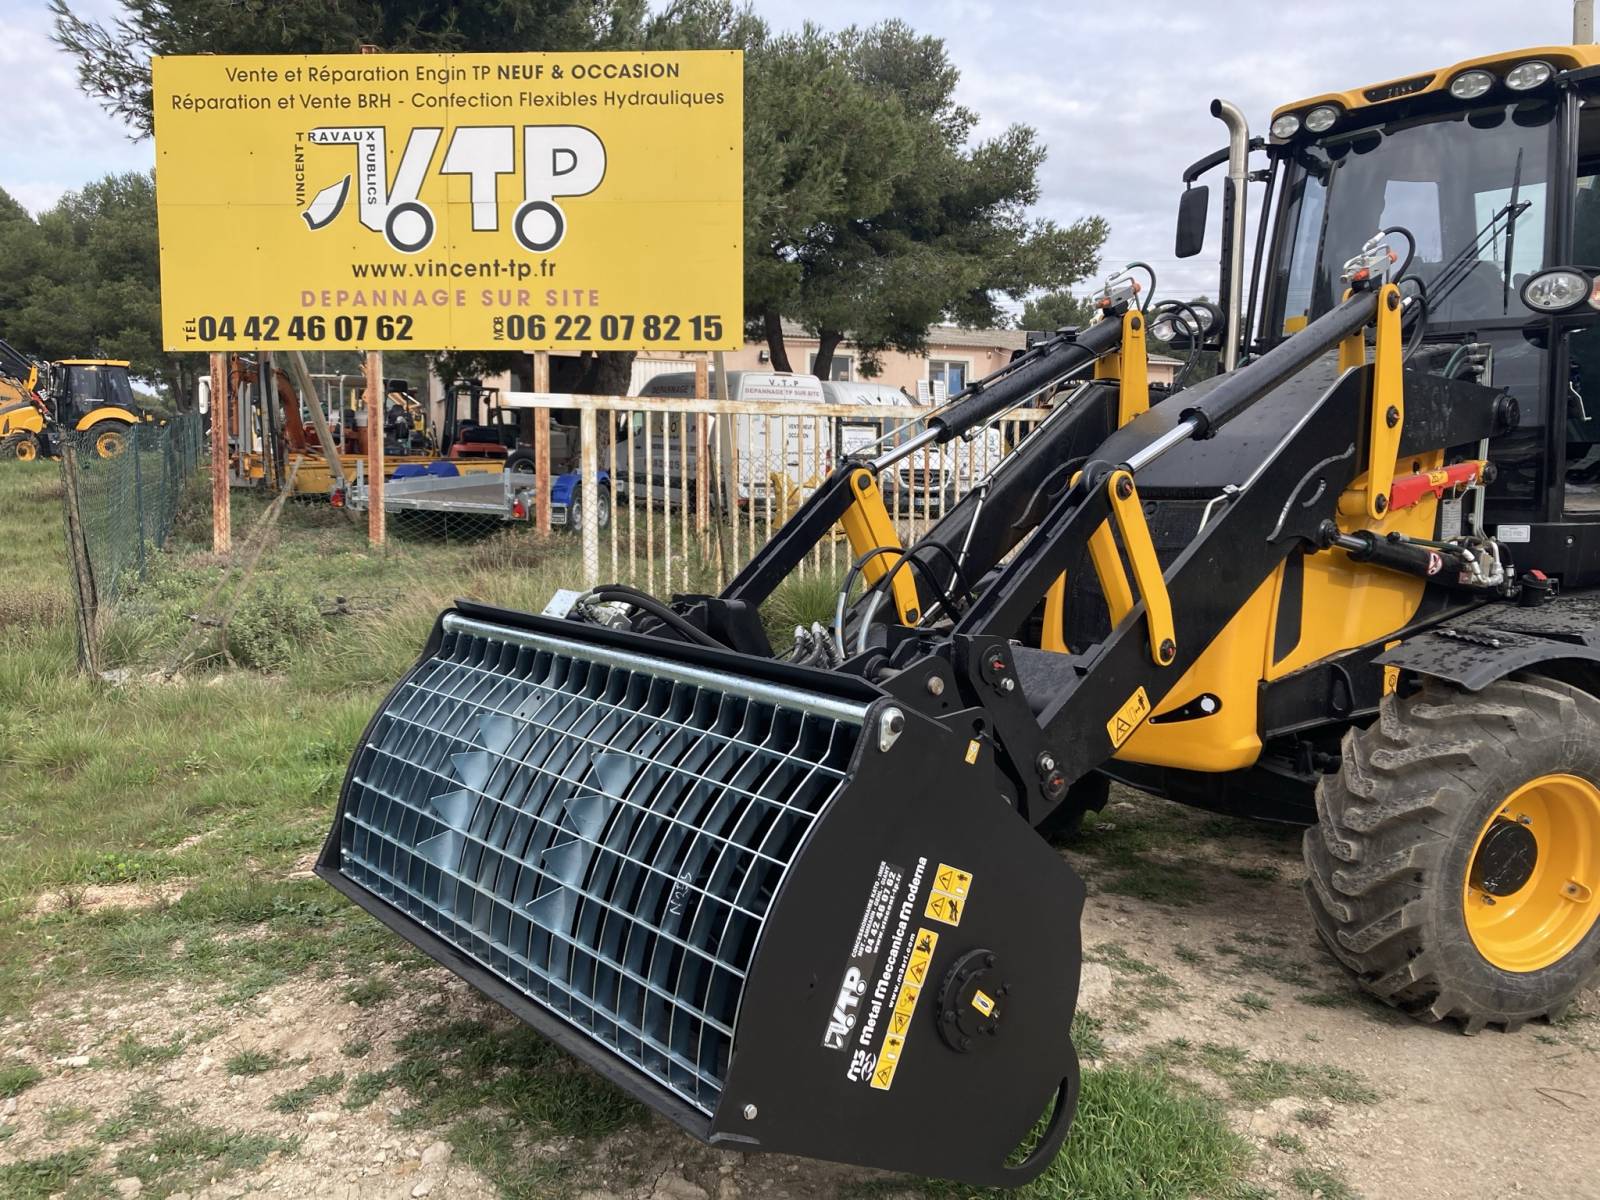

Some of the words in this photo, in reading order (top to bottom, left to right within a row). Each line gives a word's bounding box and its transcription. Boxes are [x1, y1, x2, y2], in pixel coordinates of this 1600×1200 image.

[225, 67, 278, 82] Vente
[285, 67, 302, 82] et
[309, 65, 409, 85] Réparation
[416, 65, 466, 84] Engin
[473, 65, 491, 80] TP
[497, 64, 544, 80] NEUF
[551, 64, 564, 80] &
[571, 63, 680, 79] OCCASION
[172, 94, 271, 113] Réparation
[278, 95, 295, 110] et
[300, 94, 352, 110] Vente
[358, 94, 391, 109] BRH
[411, 92, 513, 108] Confection
[520, 91, 597, 107] Flexibles
[604, 90, 725, 109] Hydrauliques
[296, 131, 376, 142] TRAVAUX
[295, 144, 305, 207] VINCENT
[366, 144, 377, 205] PUBLICS
[352, 259, 556, 281] www.vincent-tp.fr
[301, 289, 466, 307] DEPANNAGE
[481, 289, 531, 307] SUR
[546, 289, 599, 307] SITE
[182, 317, 196, 342] TÉL
[199, 316, 237, 342] 04
[244, 316, 280, 342] 42
[288, 316, 326, 342] 46
[334, 316, 368, 341] 07
[376, 315, 413, 341] 62
[493, 317, 504, 341] MOB
[507, 315, 546, 341] 06
[555, 315, 592, 341] 22
[600, 315, 635, 341] 07
[643, 315, 681, 341] 82
[688, 315, 723, 341] 15
[871, 881, 880, 898] KATO
[865, 938, 875, 954] 04
[871, 921, 880, 937] 42
[881, 888, 891, 902] 07
[887, 871, 896, 887] 62
